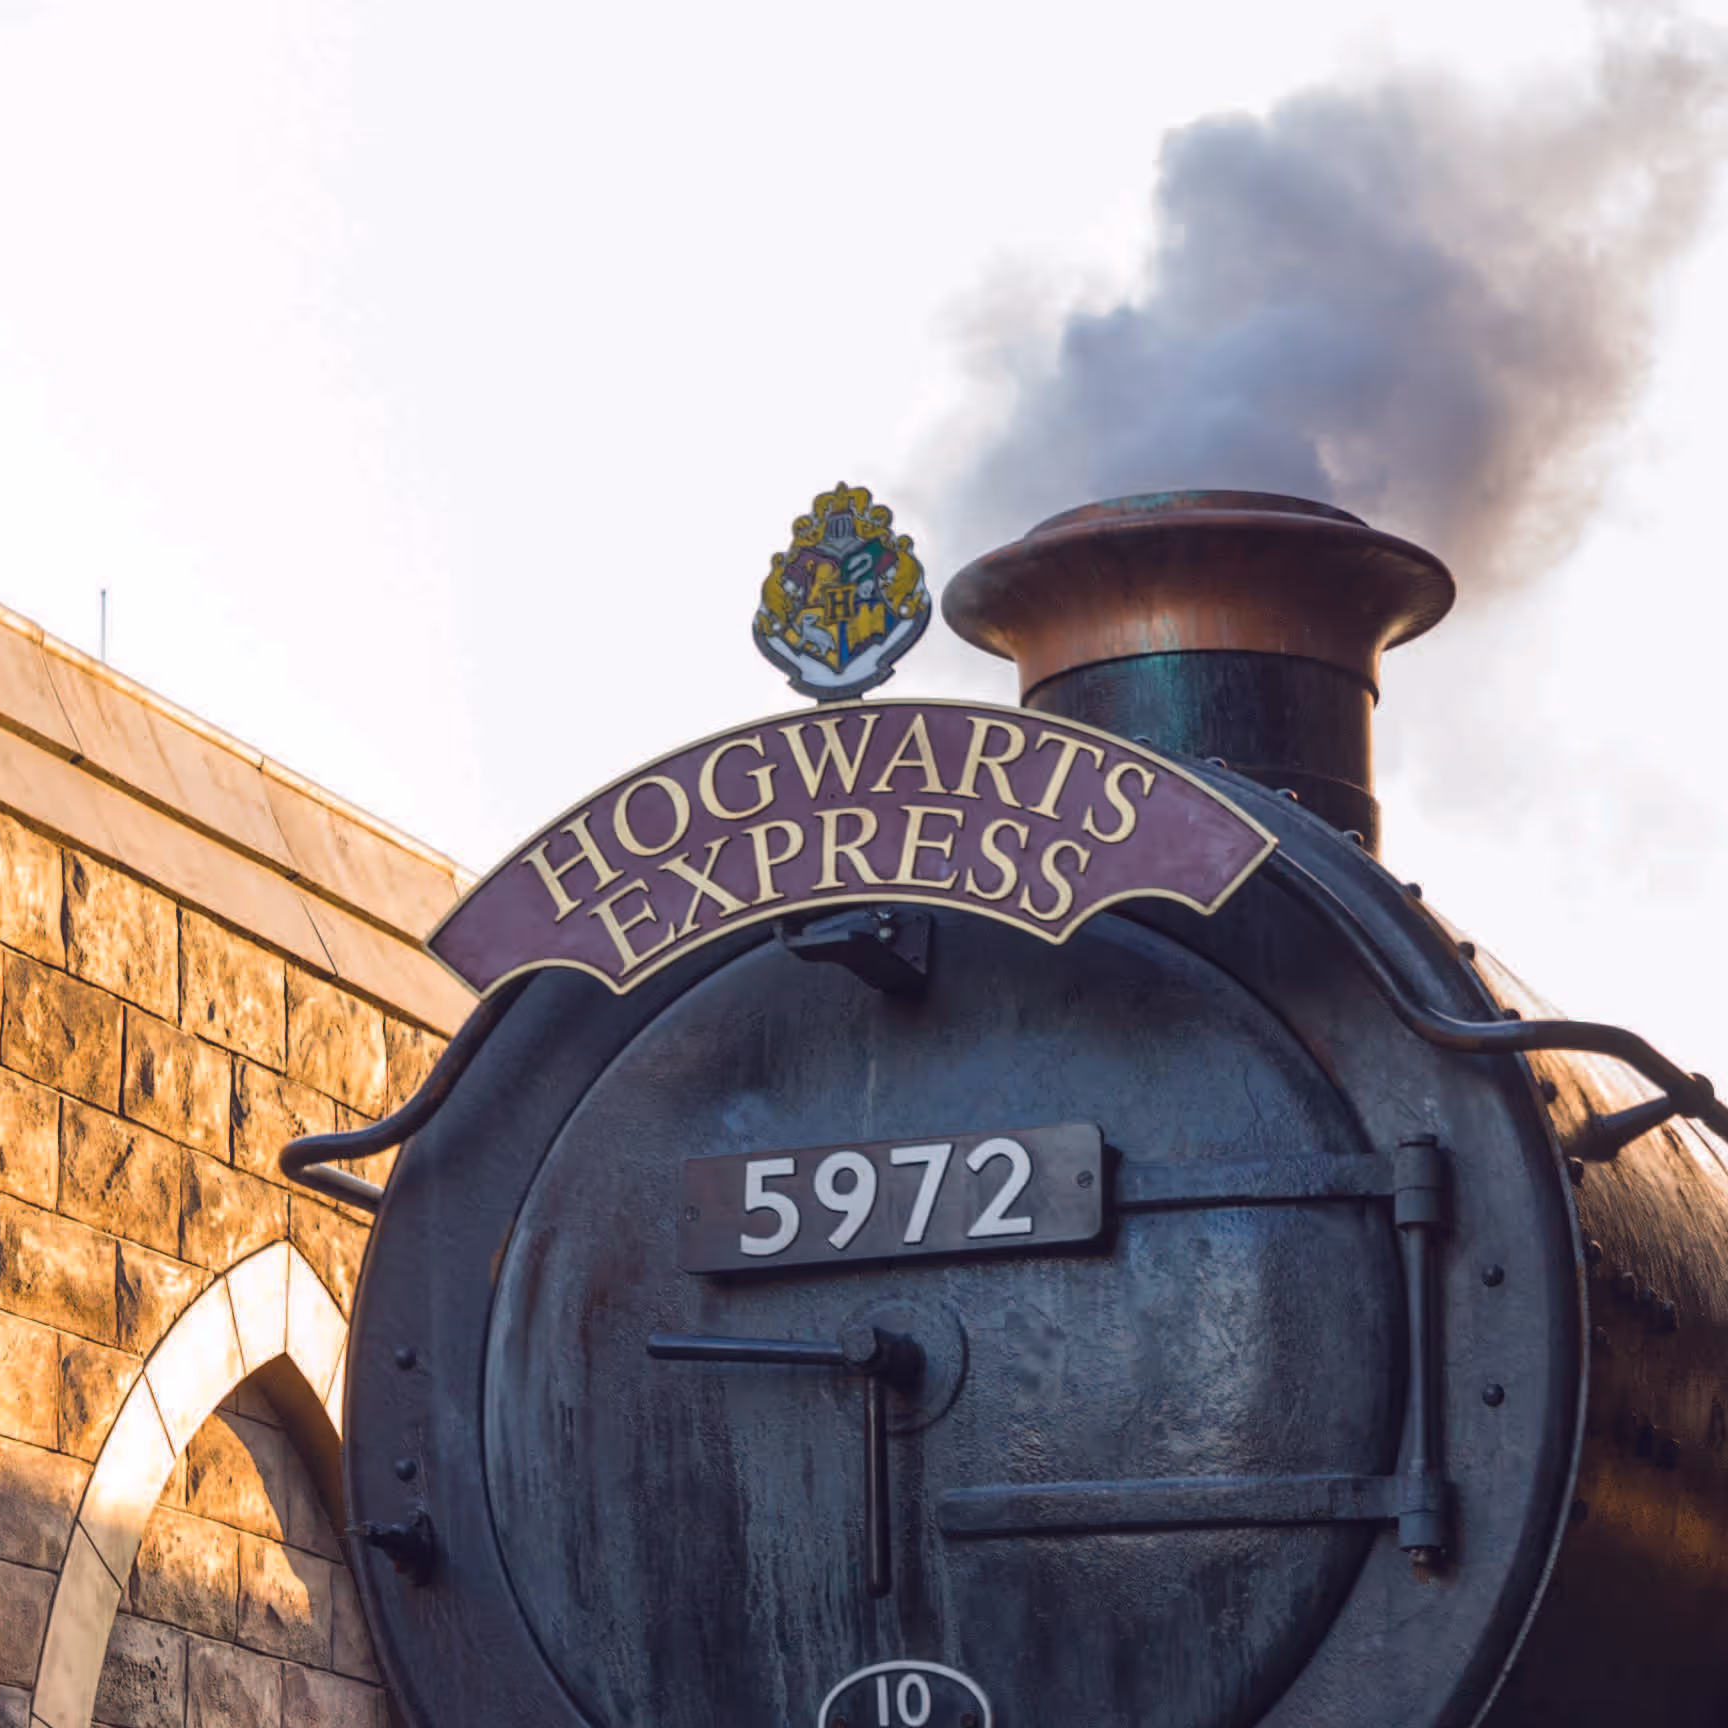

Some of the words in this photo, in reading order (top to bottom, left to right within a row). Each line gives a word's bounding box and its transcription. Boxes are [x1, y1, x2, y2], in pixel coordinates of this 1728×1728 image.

[521, 712, 1156, 921] HOGWARTS
[588, 804, 1091, 976] EXPRESS
[739, 1136, 1033, 1256] 5972
[876, 1673, 931, 1727] 10
